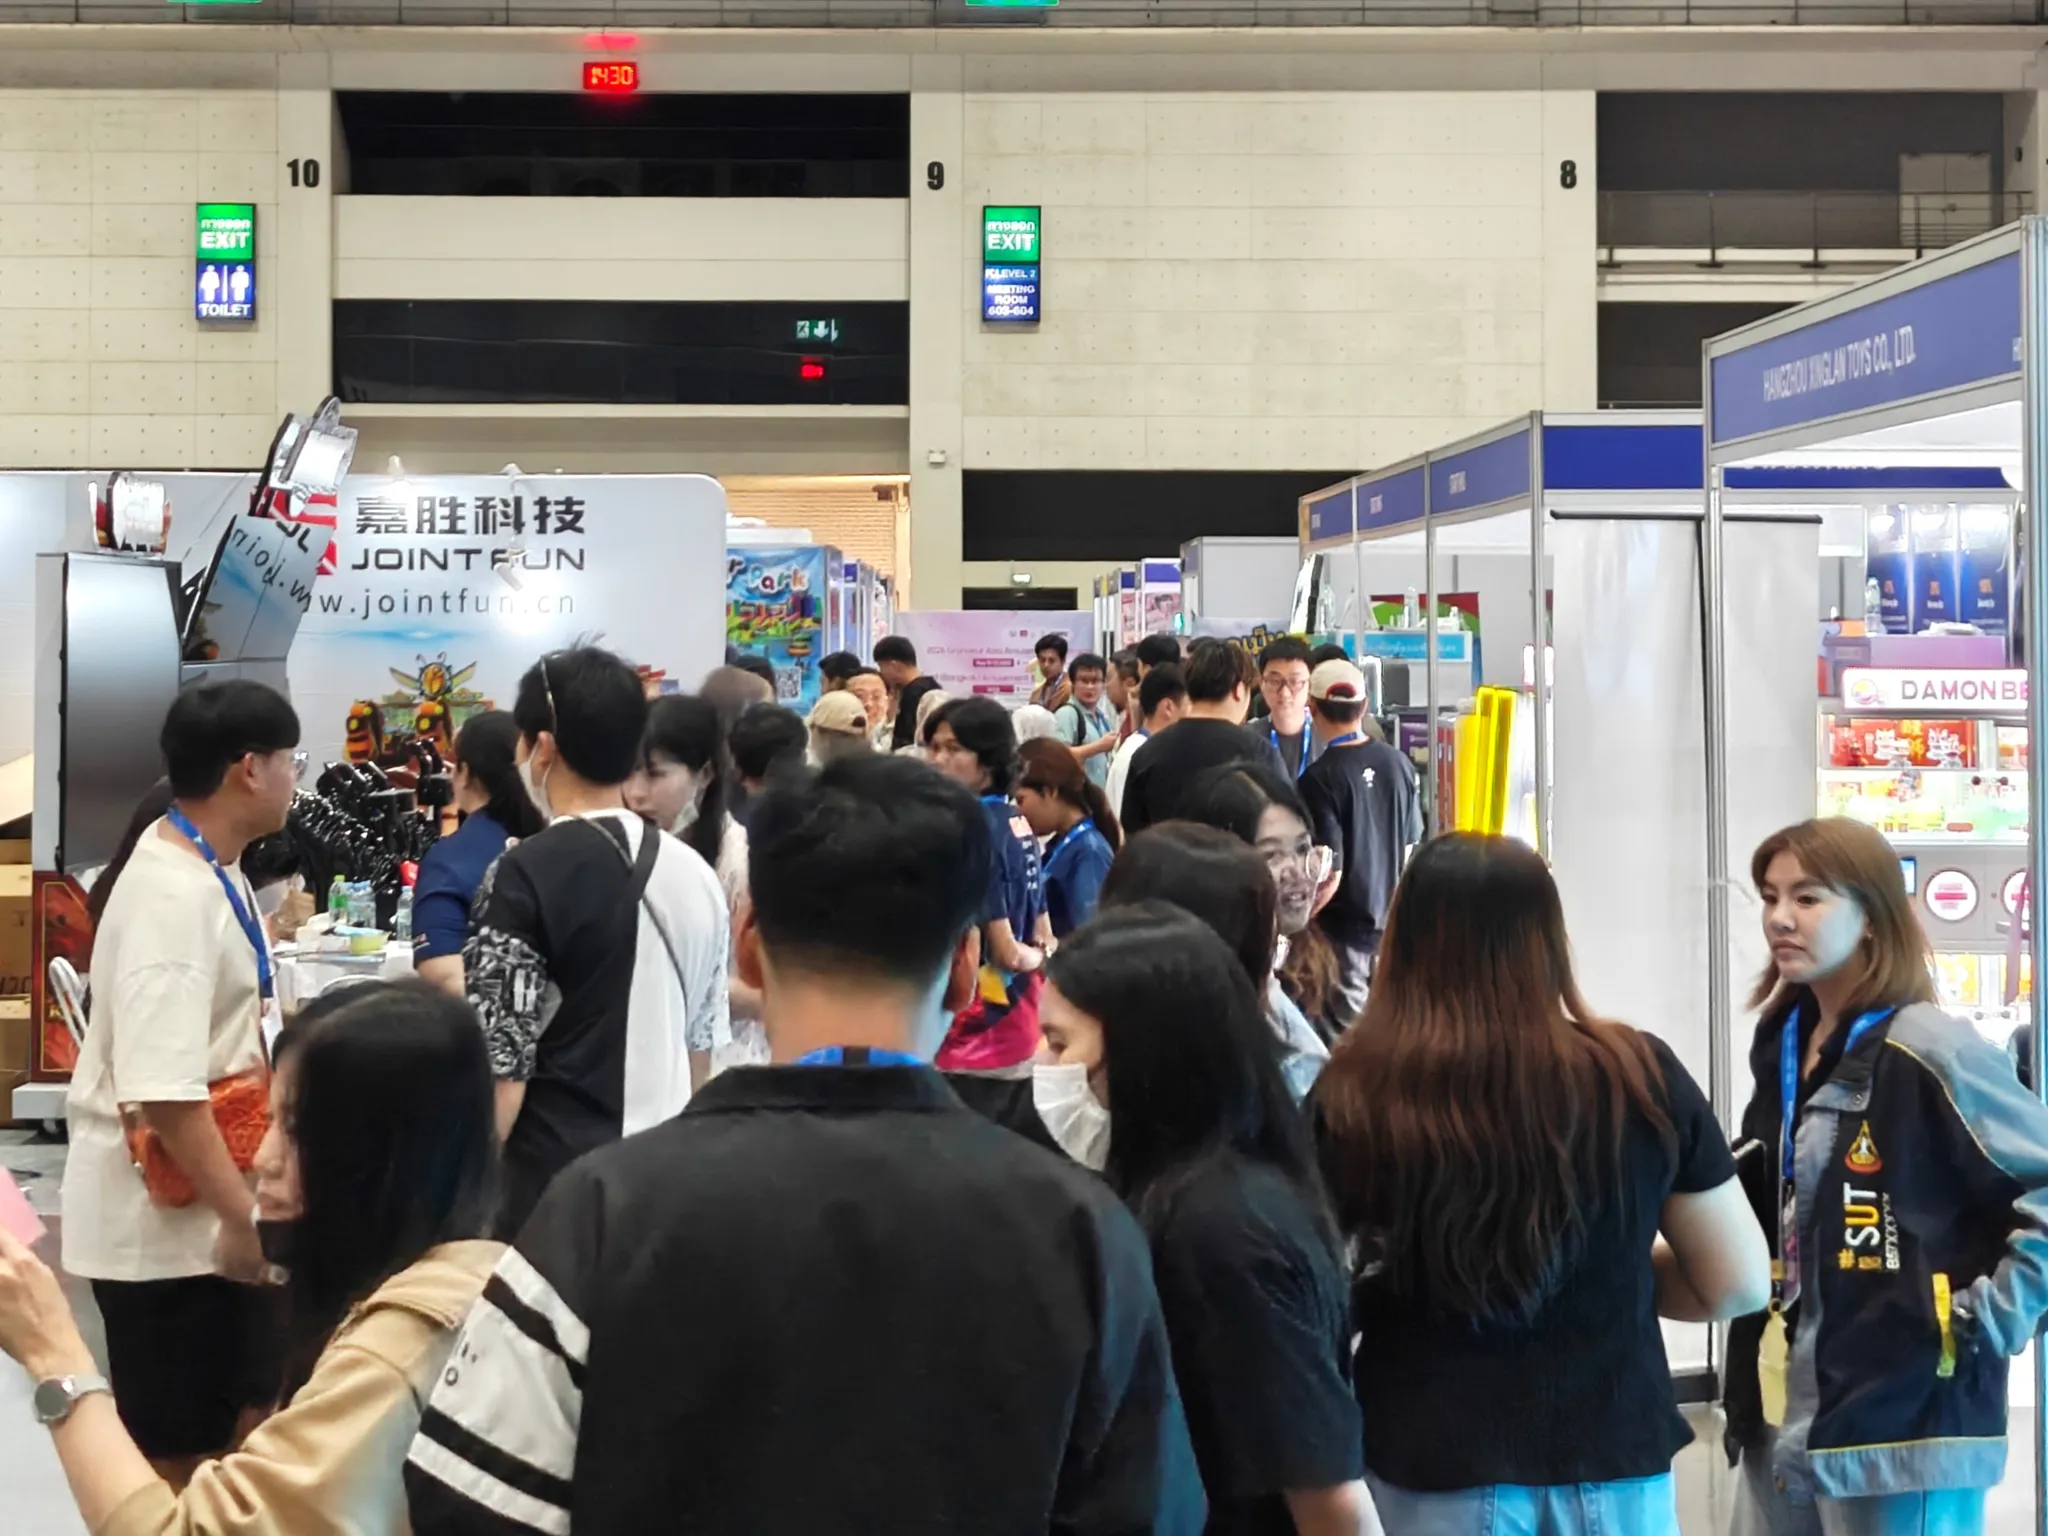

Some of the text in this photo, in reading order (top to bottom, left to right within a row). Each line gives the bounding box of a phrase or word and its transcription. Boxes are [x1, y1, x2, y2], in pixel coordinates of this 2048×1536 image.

[286, 158, 320, 188] 10
[927, 161, 945, 190] 9
[1560, 160, 1577, 189] 8
[201, 232, 250, 249] EXIT
[987, 234, 1035, 251] EXIT
[198, 304, 251, 317] TOILET
[1763, 357, 1807, 402] HANGZHOU
[1848, 338, 1871, 380] TOYS
[356, 495, 586, 535] 嘉胜科技
